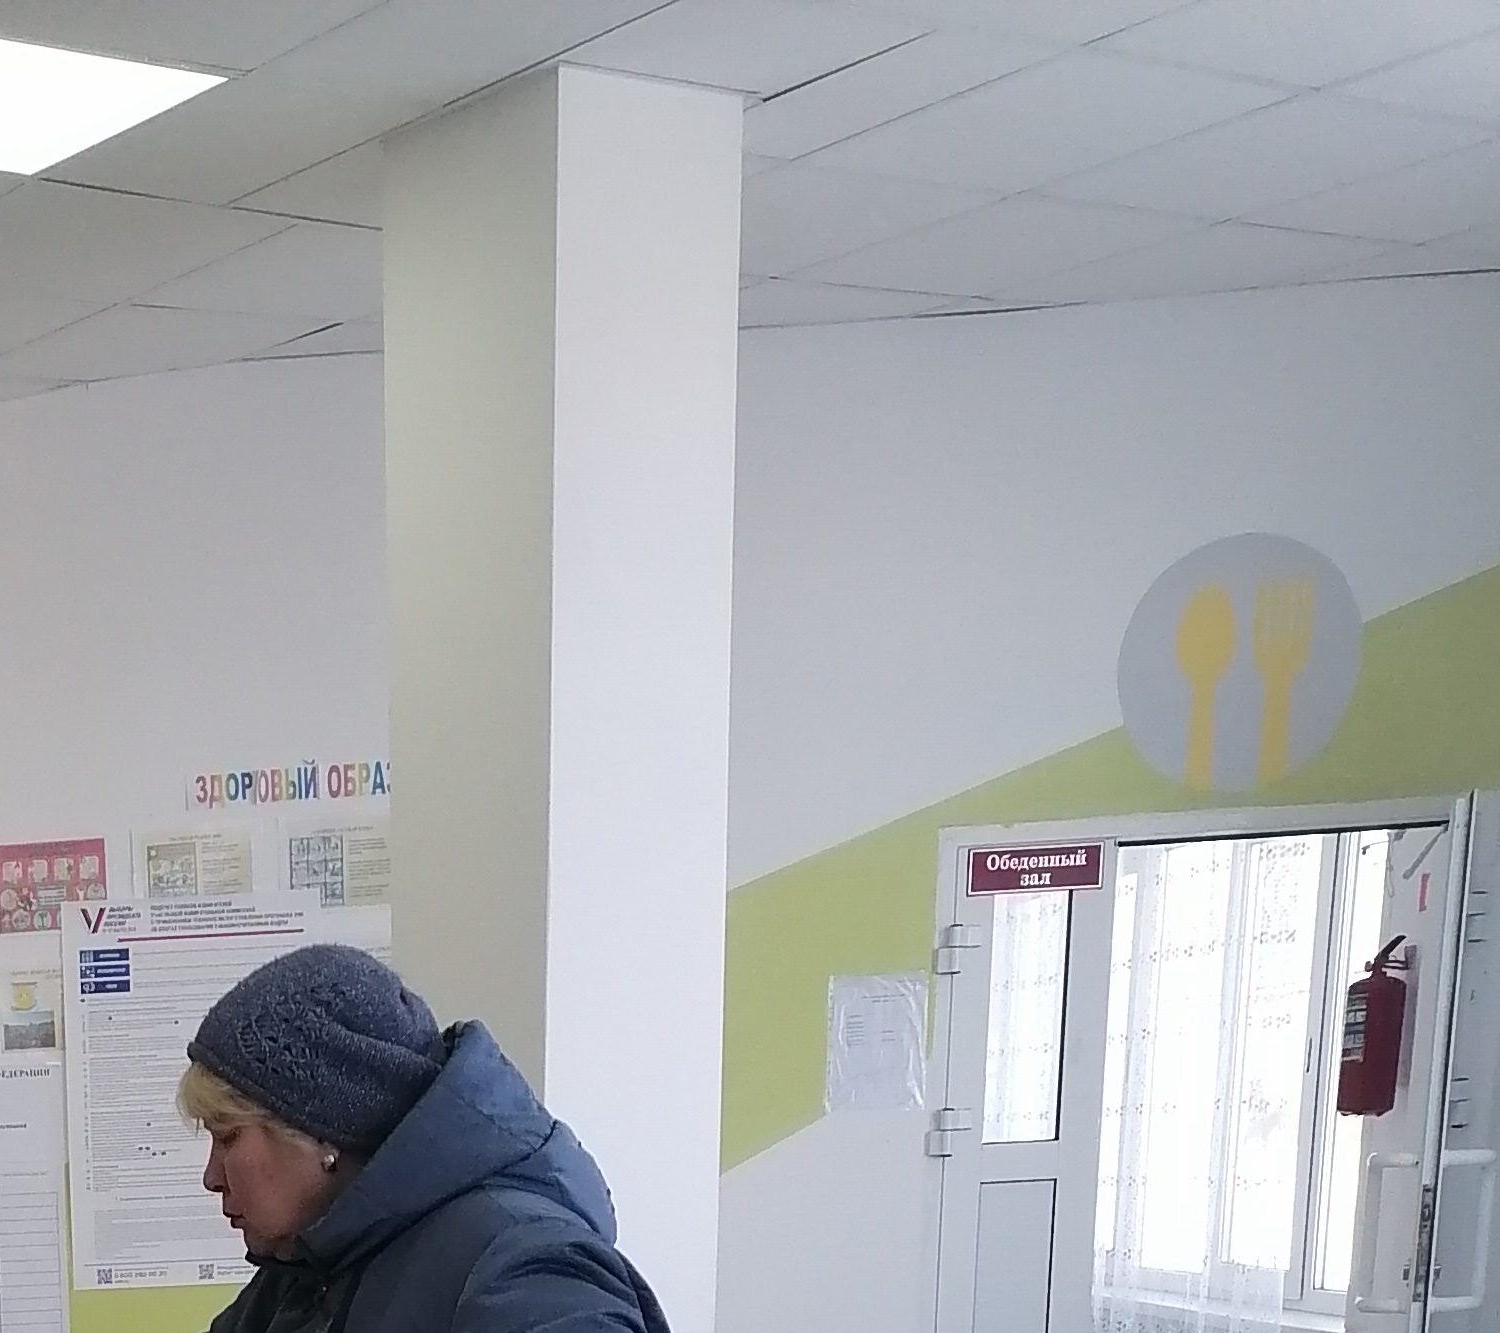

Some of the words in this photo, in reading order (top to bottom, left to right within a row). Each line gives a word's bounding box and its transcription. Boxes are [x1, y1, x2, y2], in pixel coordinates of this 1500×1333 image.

[195, 758, 319, 809] ЗДОРОВЫЙ
[986, 849, 1087, 871] Обеденный
[1020, 872, 1052, 887] зал
